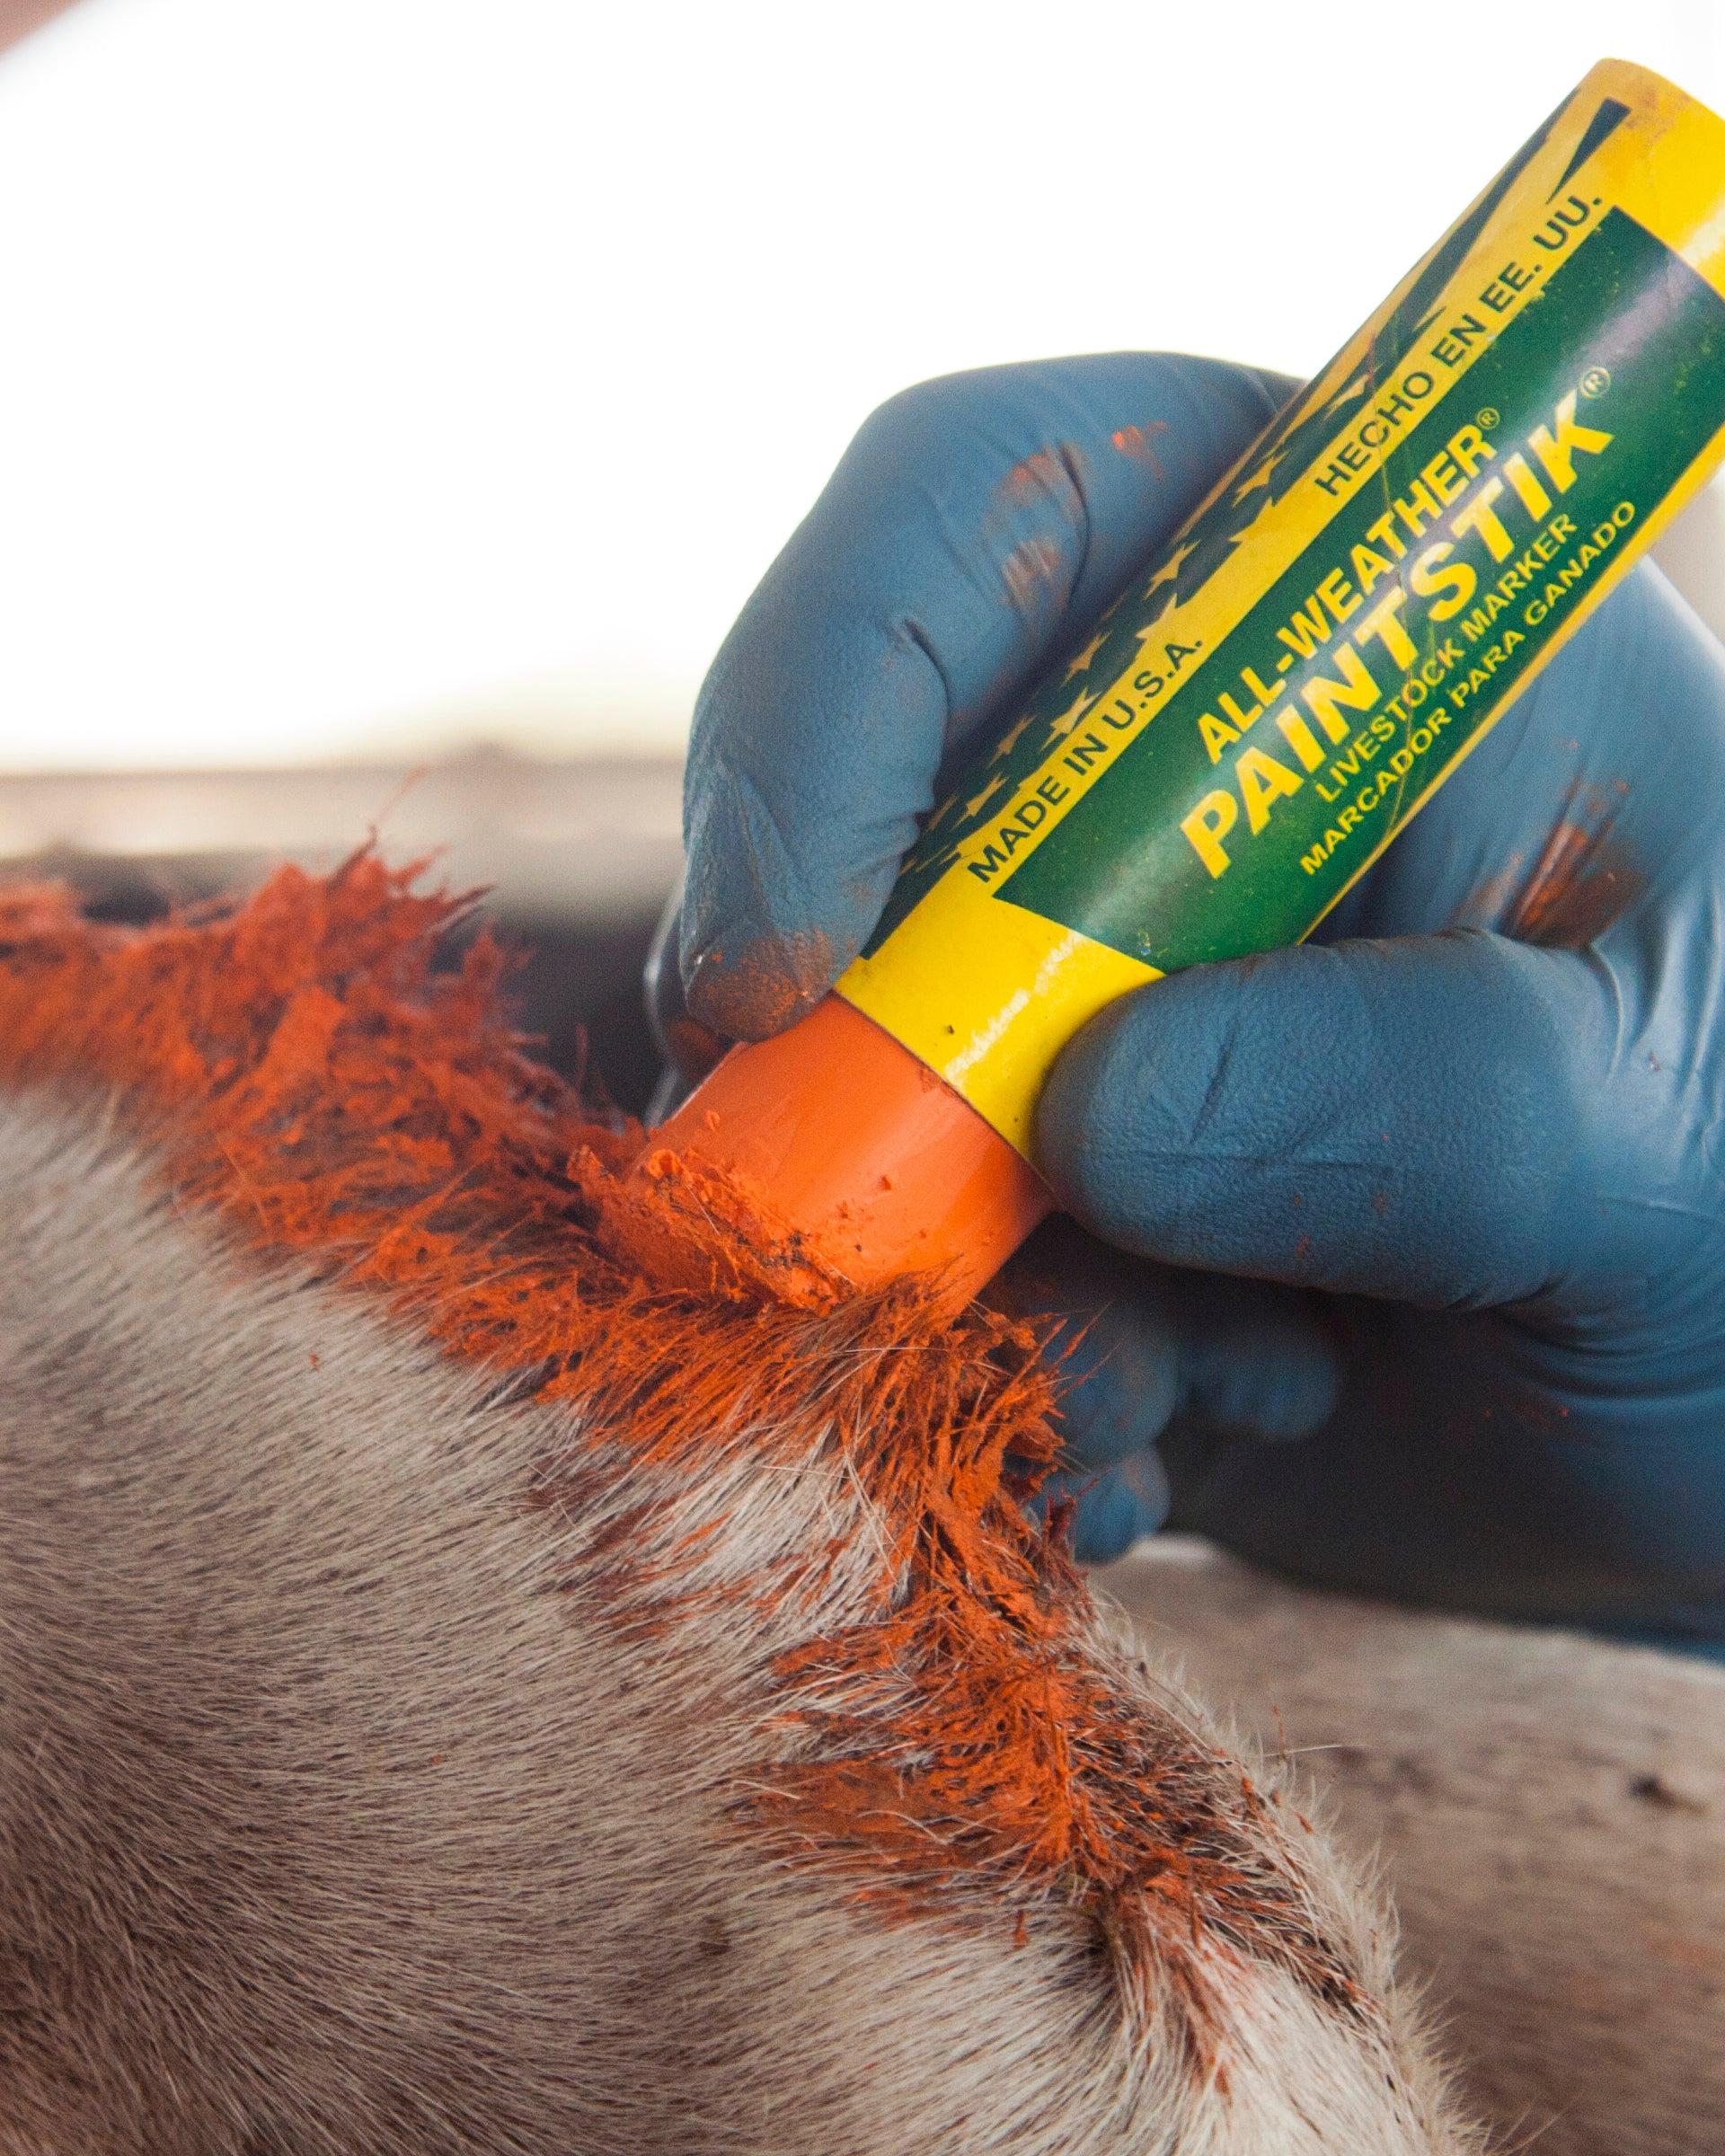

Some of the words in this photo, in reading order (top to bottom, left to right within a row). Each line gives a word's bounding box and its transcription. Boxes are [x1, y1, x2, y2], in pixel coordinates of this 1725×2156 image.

[1314, 371, 1435, 497] HECHO
[1431, 314, 1487, 368] EN
[1479, 261, 1544, 312] EE.
[1533, 196, 1603, 252] UU.
[967, 775, 1071, 884] MADE
[1062, 732, 1109, 776] IN
[1102, 637, 1204, 731] U.S.A.
[1299, 707, 1453, 876] MARCADOR
[1447, 628, 1526, 709] PARA
[1524, 500, 1637, 626] GANADO
[1314, 639, 1467, 803] LIVESTOCK
[1459, 513, 1578, 643] MARKER
